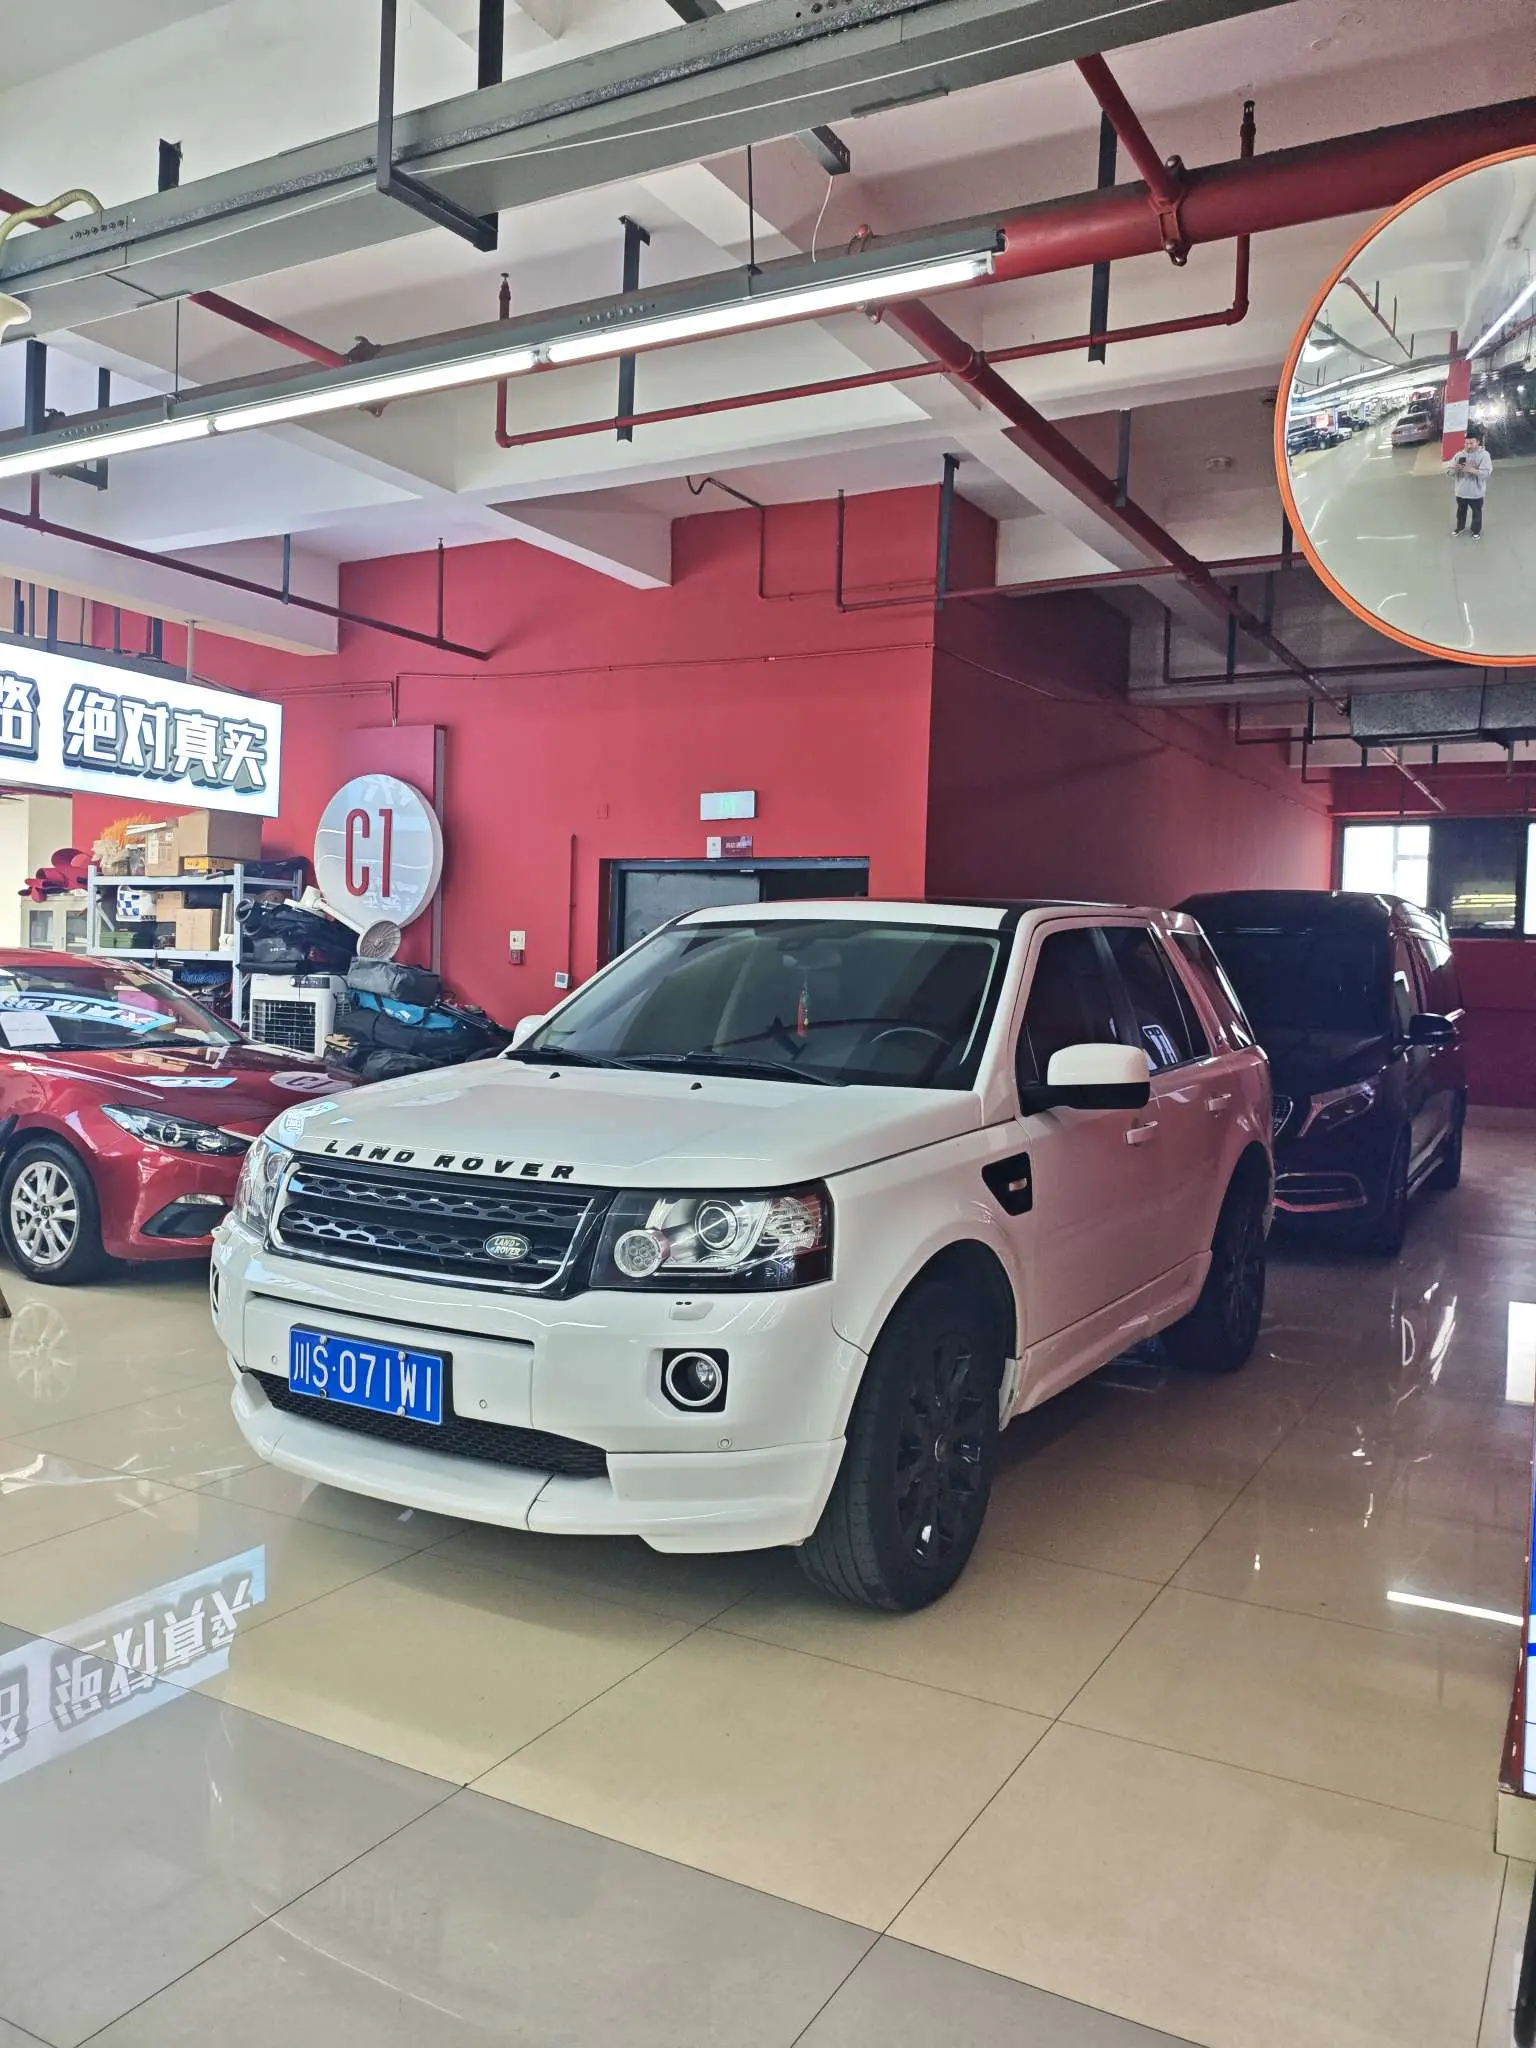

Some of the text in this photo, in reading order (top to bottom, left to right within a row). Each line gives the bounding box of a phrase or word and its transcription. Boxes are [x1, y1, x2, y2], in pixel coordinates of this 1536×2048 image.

[64, 686, 267, 790] 绝对真实
[345, 808, 393, 897] C1
[326, 1139, 574, 1180] LAND ROVER
[493, 1245, 521, 1256] ROVER
[495, 1237, 516, 1247] LAND
